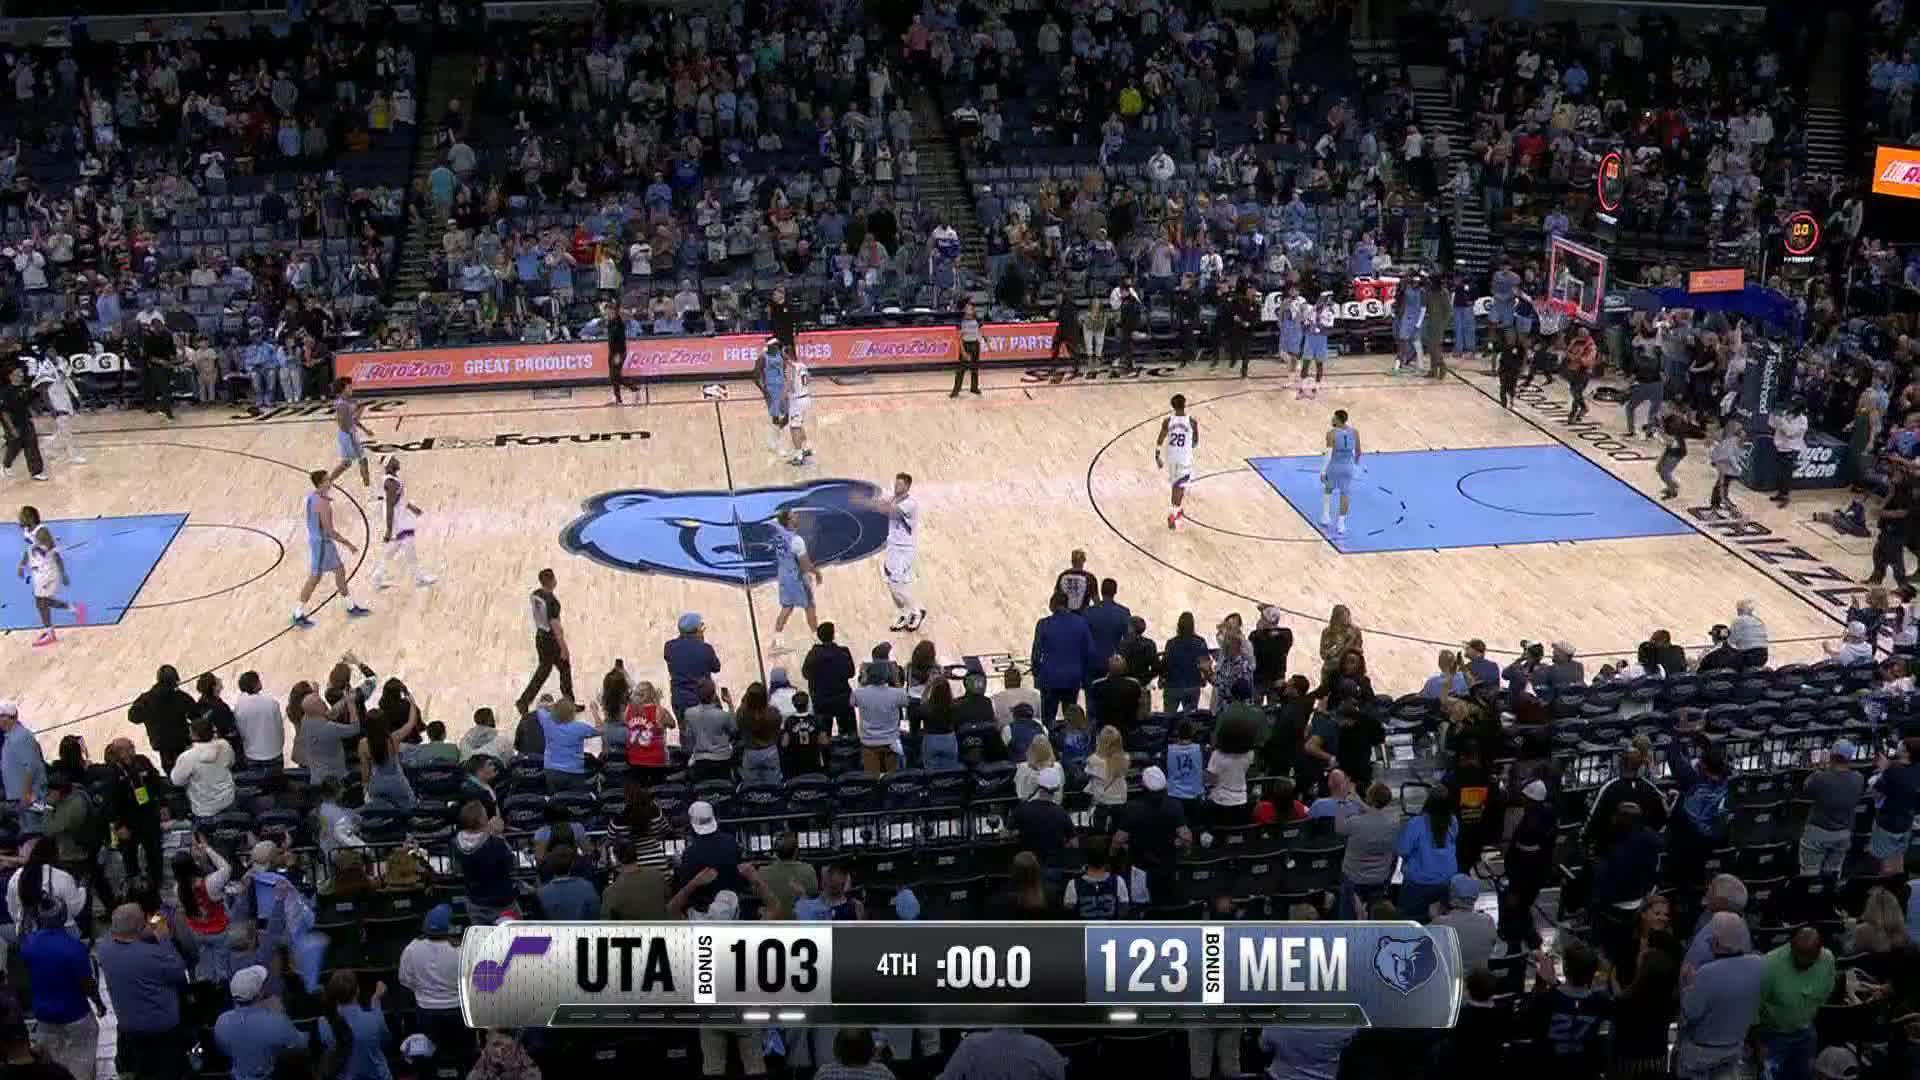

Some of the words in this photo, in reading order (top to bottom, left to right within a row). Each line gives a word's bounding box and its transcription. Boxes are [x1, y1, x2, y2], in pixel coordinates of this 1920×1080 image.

[1011, 335, 1053, 350] PARTS
[99, 355, 112, 370] G
[464, 358, 511, 375] GREAT
[515, 354, 592, 372] PRODUCTS
[1169, 432, 1186, 447] 28
